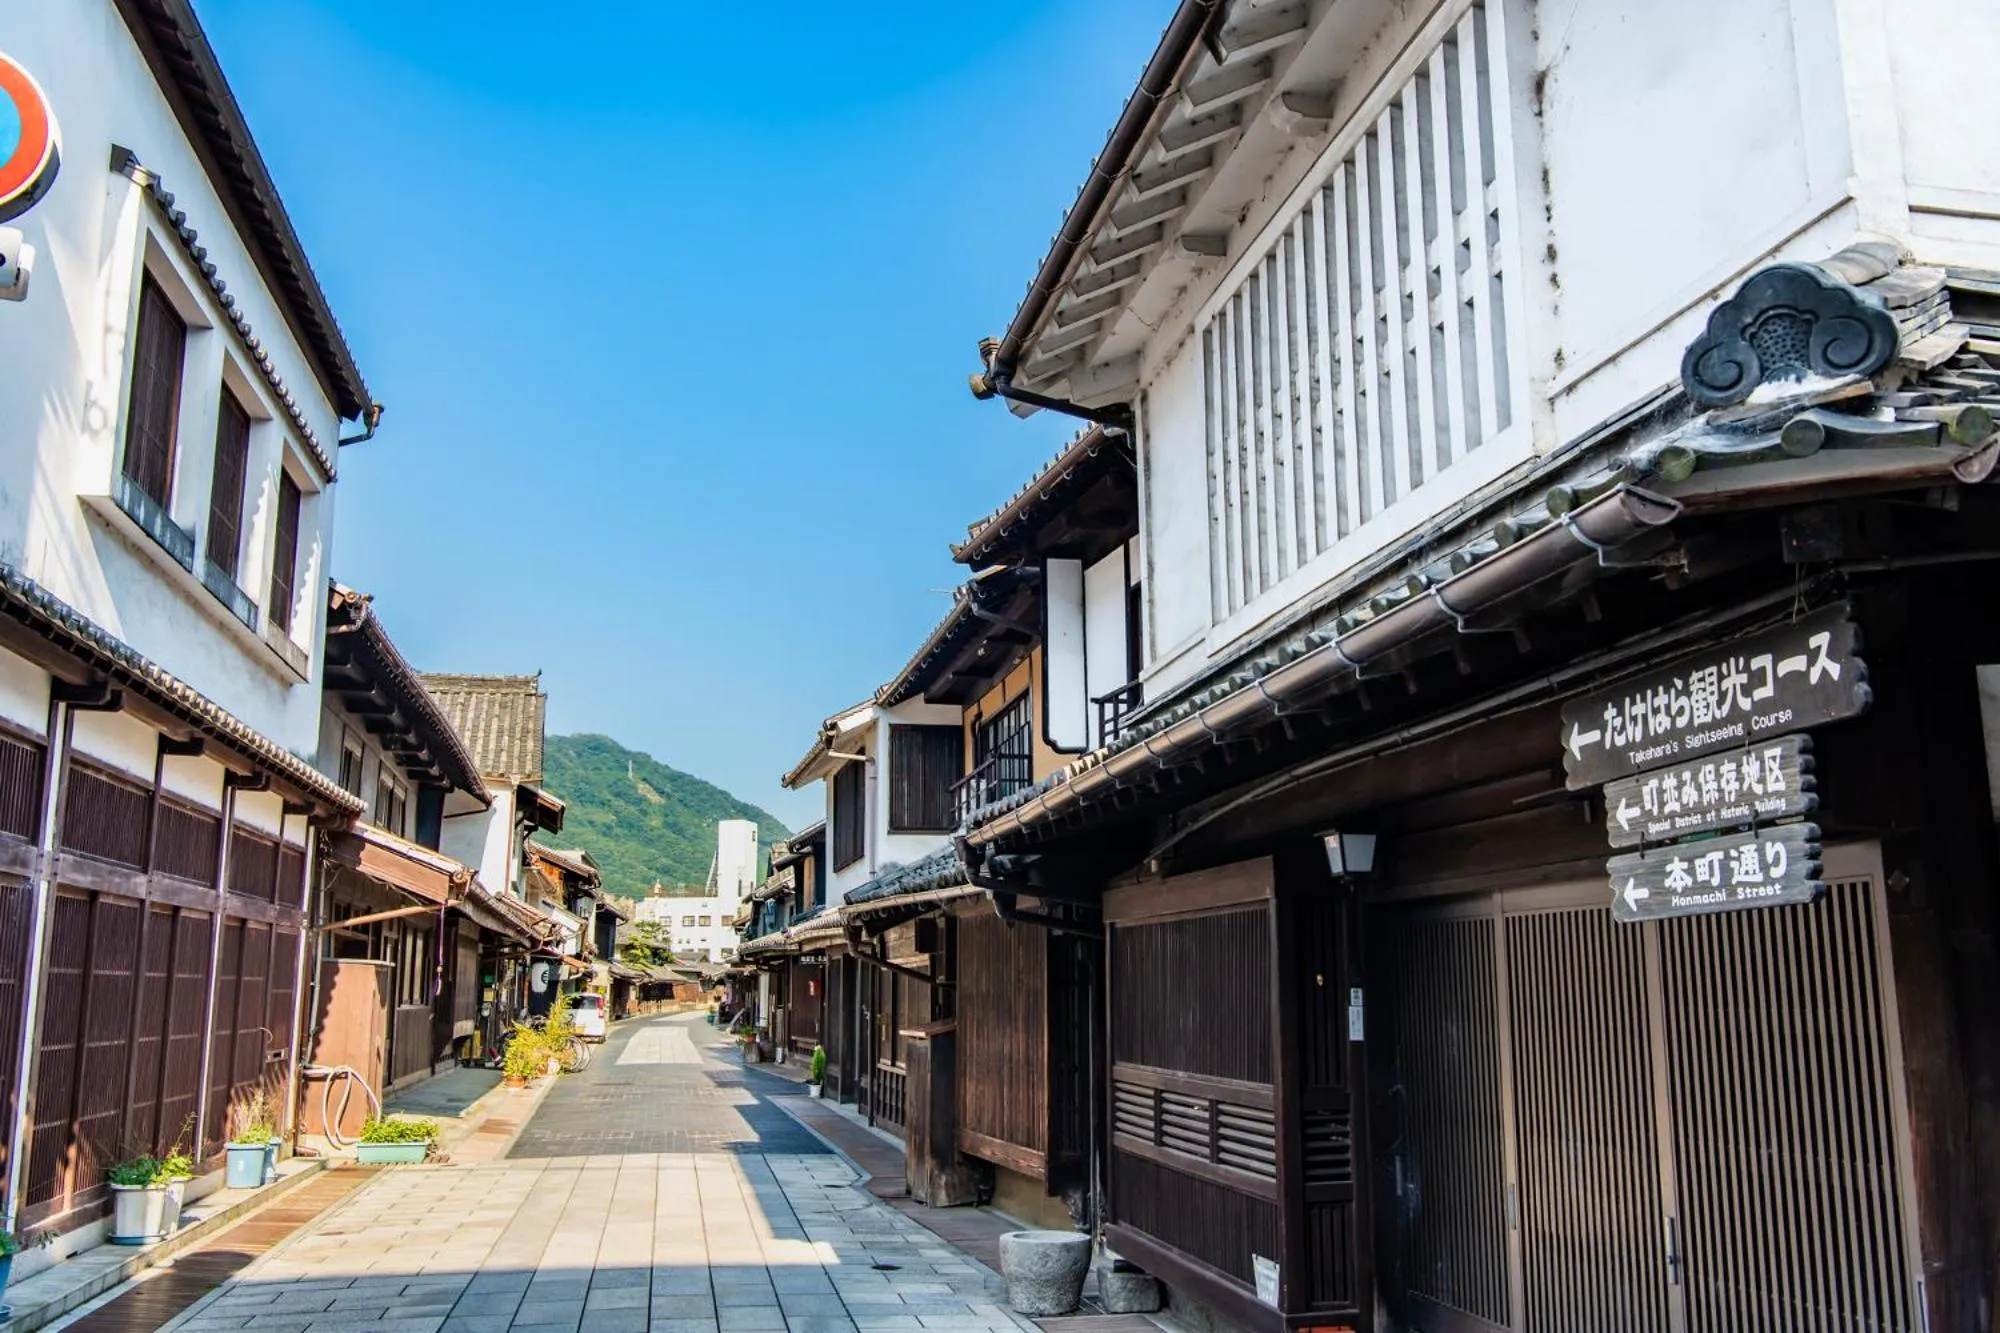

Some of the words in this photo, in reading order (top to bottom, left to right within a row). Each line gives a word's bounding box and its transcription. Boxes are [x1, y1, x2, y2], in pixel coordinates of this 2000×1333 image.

[1604, 631, 1841, 750] たけはら観光コース
[1628, 740, 1678, 765] Takehara's
[1685, 722, 1743, 752] Sightseeing
[1751, 708, 1793, 730] Course
[1642, 747, 1786, 816] 町並み保存地区
[1647, 818, 1671, 834] Special
[1675, 813, 1702, 828] District
[1706, 811, 1716, 822] of
[1720, 803, 1749, 819] Historic
[1664, 841, 1787, 892] 本町通り
[1671, 887, 1727, 907] Honmachi
[1737, 882, 1782, 900] Street
